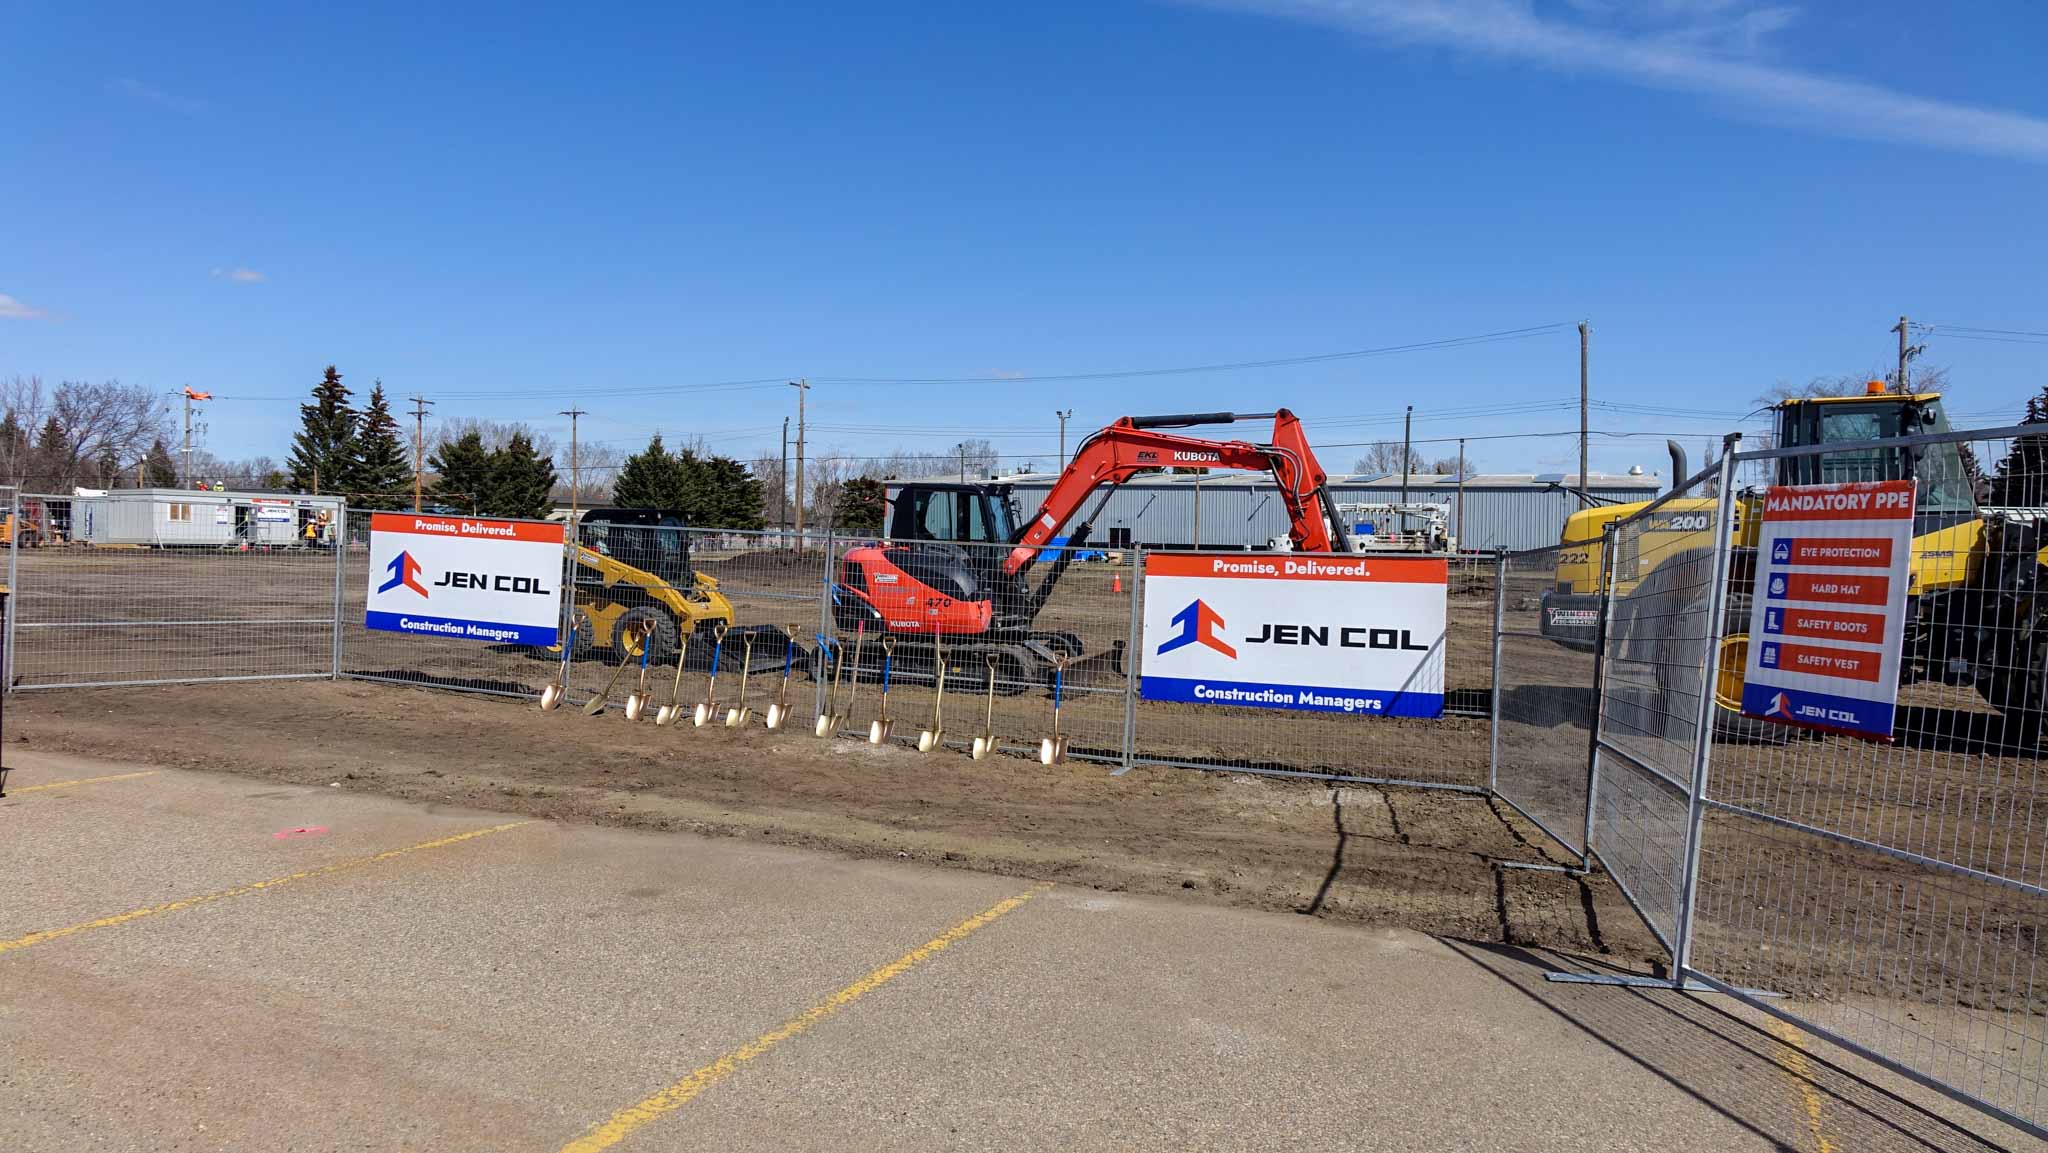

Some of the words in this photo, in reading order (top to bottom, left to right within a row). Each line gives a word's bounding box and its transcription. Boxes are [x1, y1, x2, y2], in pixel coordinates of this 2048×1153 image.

[1174, 451, 1221, 462] KUBOTA
[1767, 494, 1872, 512] MANDATORY
[1875, 491, 1910, 509] PPE
[415, 519, 459, 535] Promise,
[461, 522, 516, 537] Delivered.
[1800, 547, 1818, 557] EYE
[1819, 548, 1880, 558] PROTECTION
[1213, 559, 1280, 577] Promise,
[1284, 561, 1371, 577] Delivered.
[434, 571, 488, 590] JEN
[494, 576, 550, 595] COL
[1811, 583, 1838, 594] HARD
[1840, 585, 1861, 595] HAT
[926, 598, 952, 607] 470
[400, 617, 464, 635] Construction
[466, 625, 520, 640] Managers
[1797, 618, 1832, 630] SAFETY
[1833, 621, 1868, 633] BOOTS
[1245, 624, 1329, 646] JEN
[1340, 627, 1429, 650] COL
[1797, 654, 1832, 667] SAFETY
[1834, 658, 1860, 671] VEST
[1193, 684, 1293, 705] Construction
[1298, 691, 1382, 711] Managers
[1795, 705, 1827, 718] JEN
[1828, 710, 1860, 724] COL
